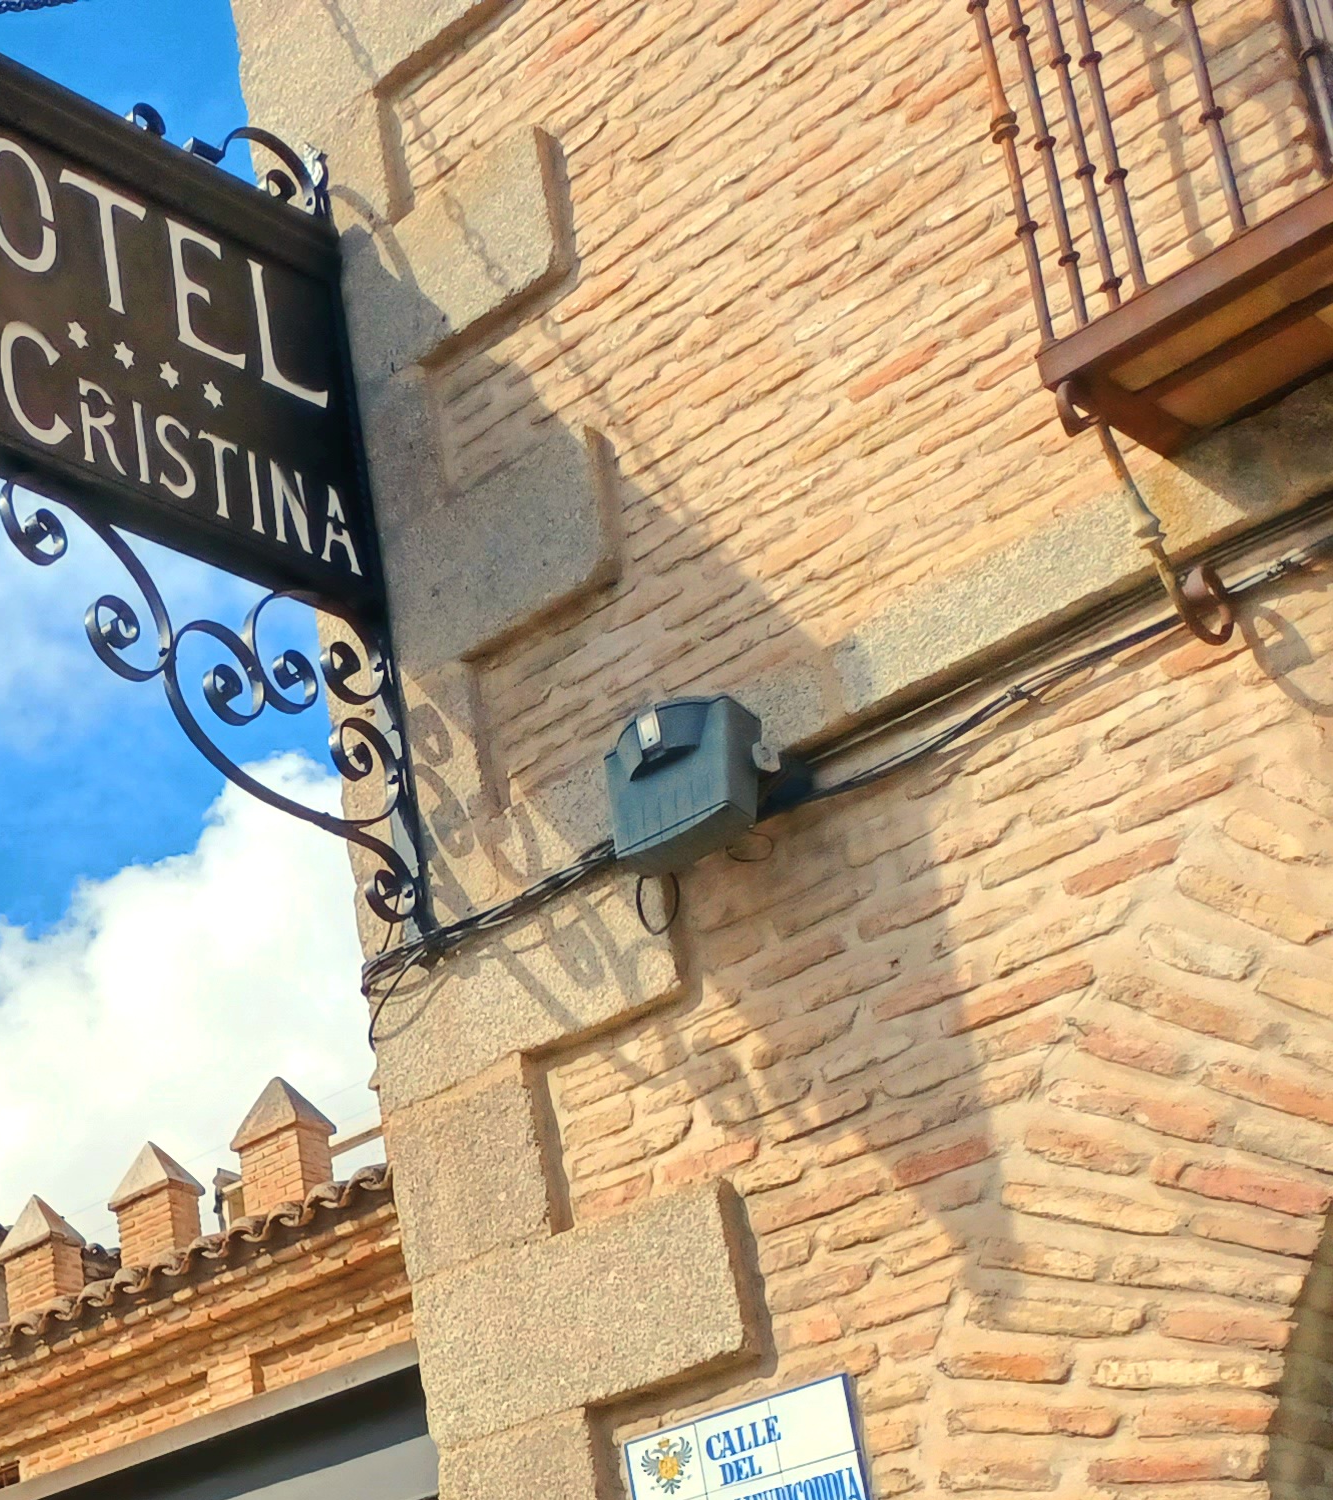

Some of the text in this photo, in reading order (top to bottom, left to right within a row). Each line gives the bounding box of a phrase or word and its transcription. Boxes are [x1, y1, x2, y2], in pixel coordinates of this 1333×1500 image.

[0, 321, 364, 577] CRISTINA
[705, 1415, 782, 1461] CALLE
[720, 1455, 763, 1486] DEL
